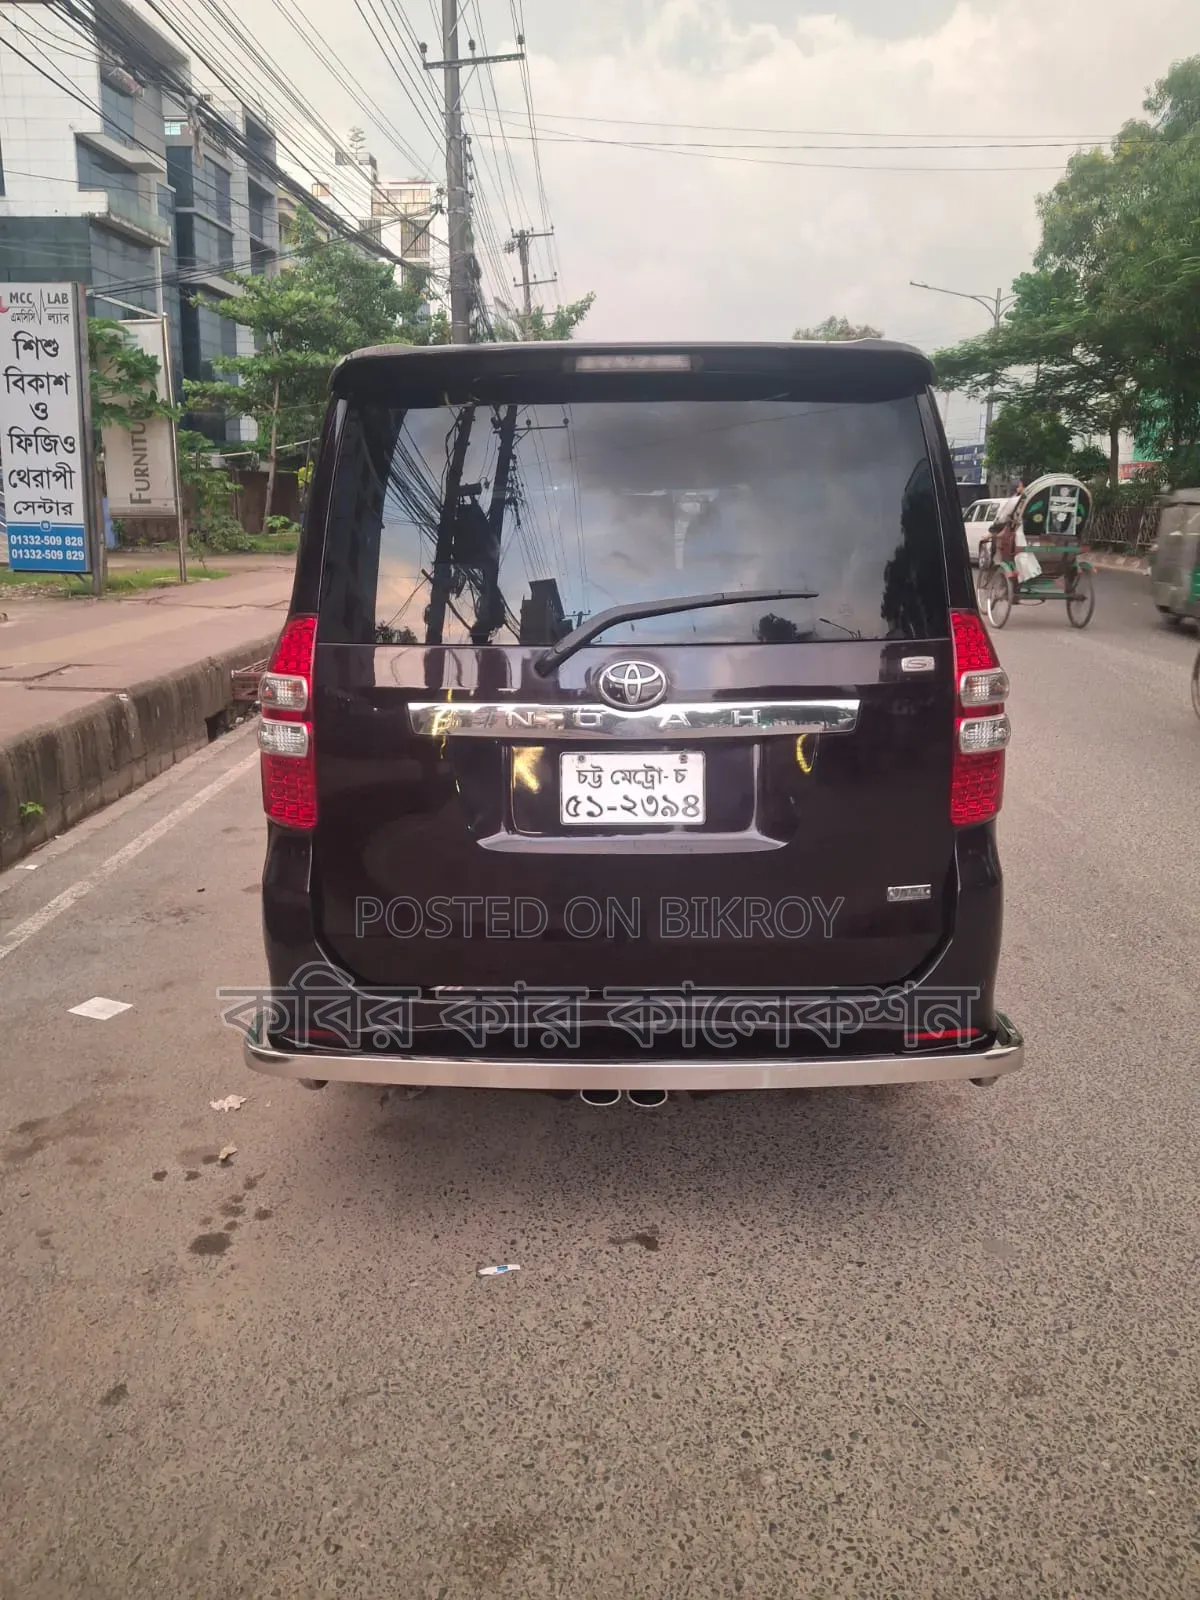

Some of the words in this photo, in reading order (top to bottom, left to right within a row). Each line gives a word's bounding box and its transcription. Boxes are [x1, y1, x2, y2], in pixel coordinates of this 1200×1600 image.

[9, 292, 33, 304] MCC
[47, 292, 69, 304] LAB
[47, 312, 70, 324] ল্যাব
[11, 330, 59, 360] শিশু
[3, 365, 71, 395] বিকাশ
[29, 402, 48, 420] ও
[7, 426, 76, 455] ফিজিও
[8, 462, 76, 489] থেরাপী
[13, 496, 75, 516] সেন্টার
[10, 535, 62, 546] 01332-509
[65, 536, 83, 546] 828
[11, 549, 63, 560] 01332-509
[66, 550, 84, 561] 829
[504, 708, 763, 729] NOAH
[576, 764, 604, 789] চট্ট
[673, 768, 688, 784] চ
[565, 794, 700, 818] ৫১-২৩৯৪
